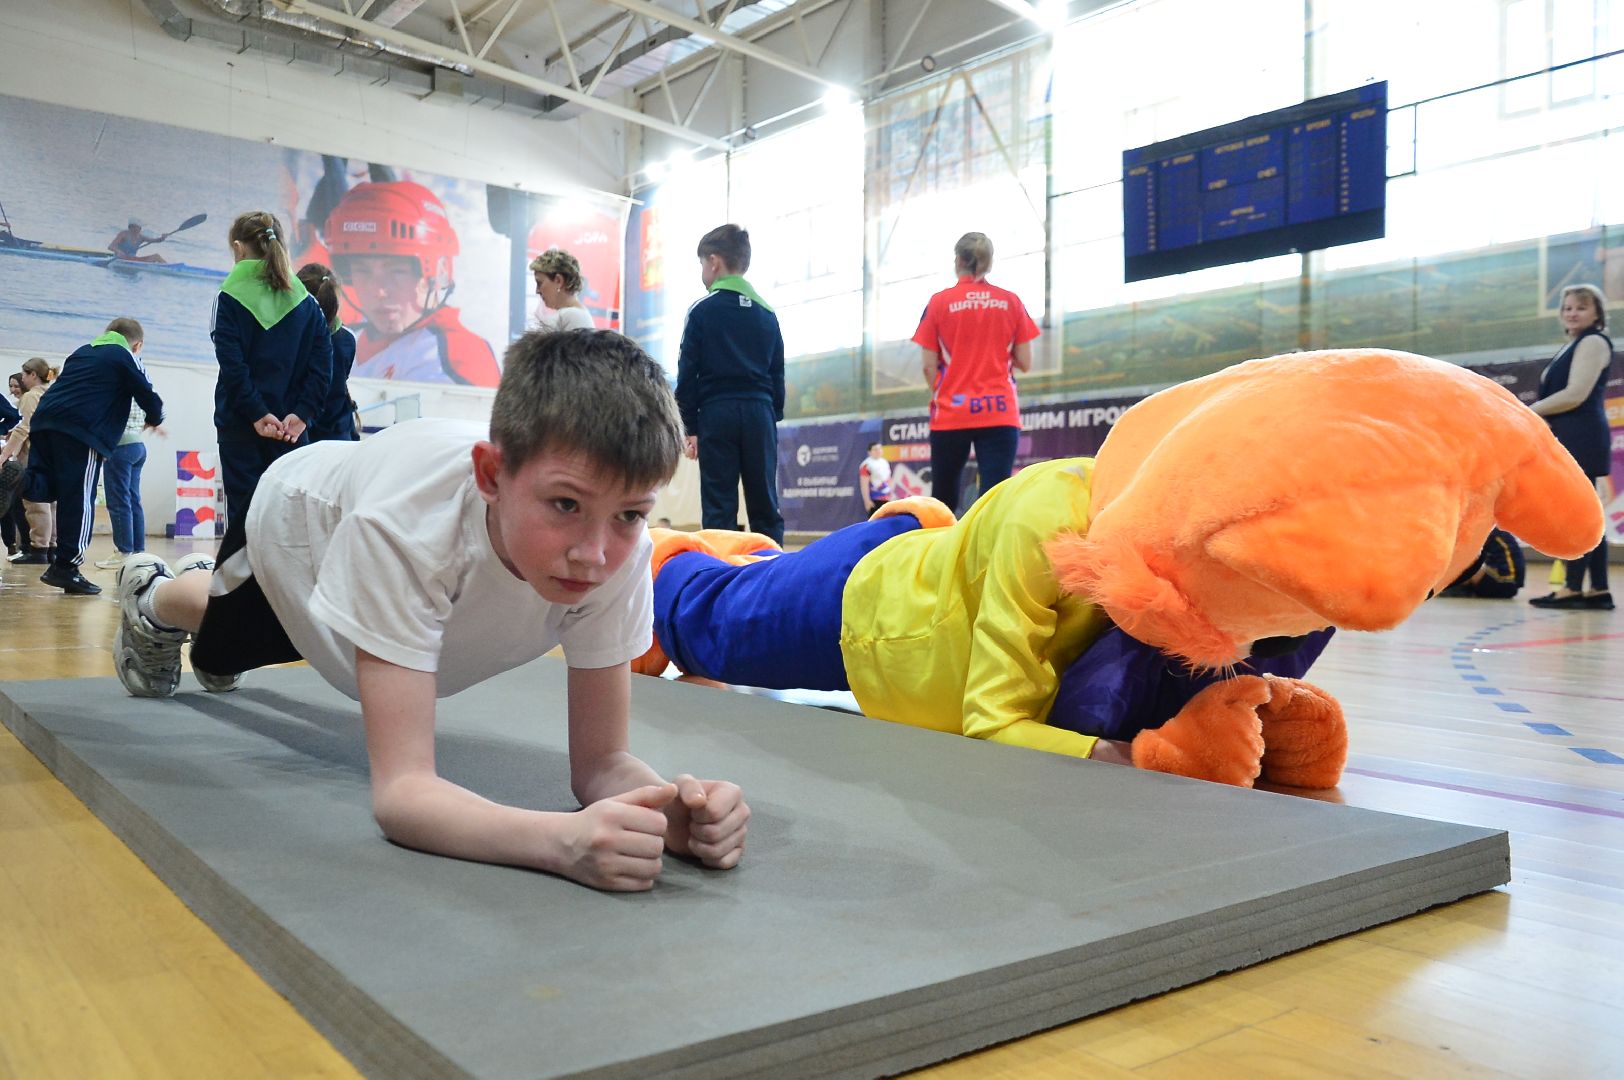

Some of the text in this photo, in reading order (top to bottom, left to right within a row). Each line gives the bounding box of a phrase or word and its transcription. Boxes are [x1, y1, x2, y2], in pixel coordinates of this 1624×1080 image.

[966, 291, 990, 300] СШ
[949, 299, 1008, 313] ШАТУРА
[970, 395, 1007, 414] ВТБ
[1068, 405, 1128, 428] ИГРО
